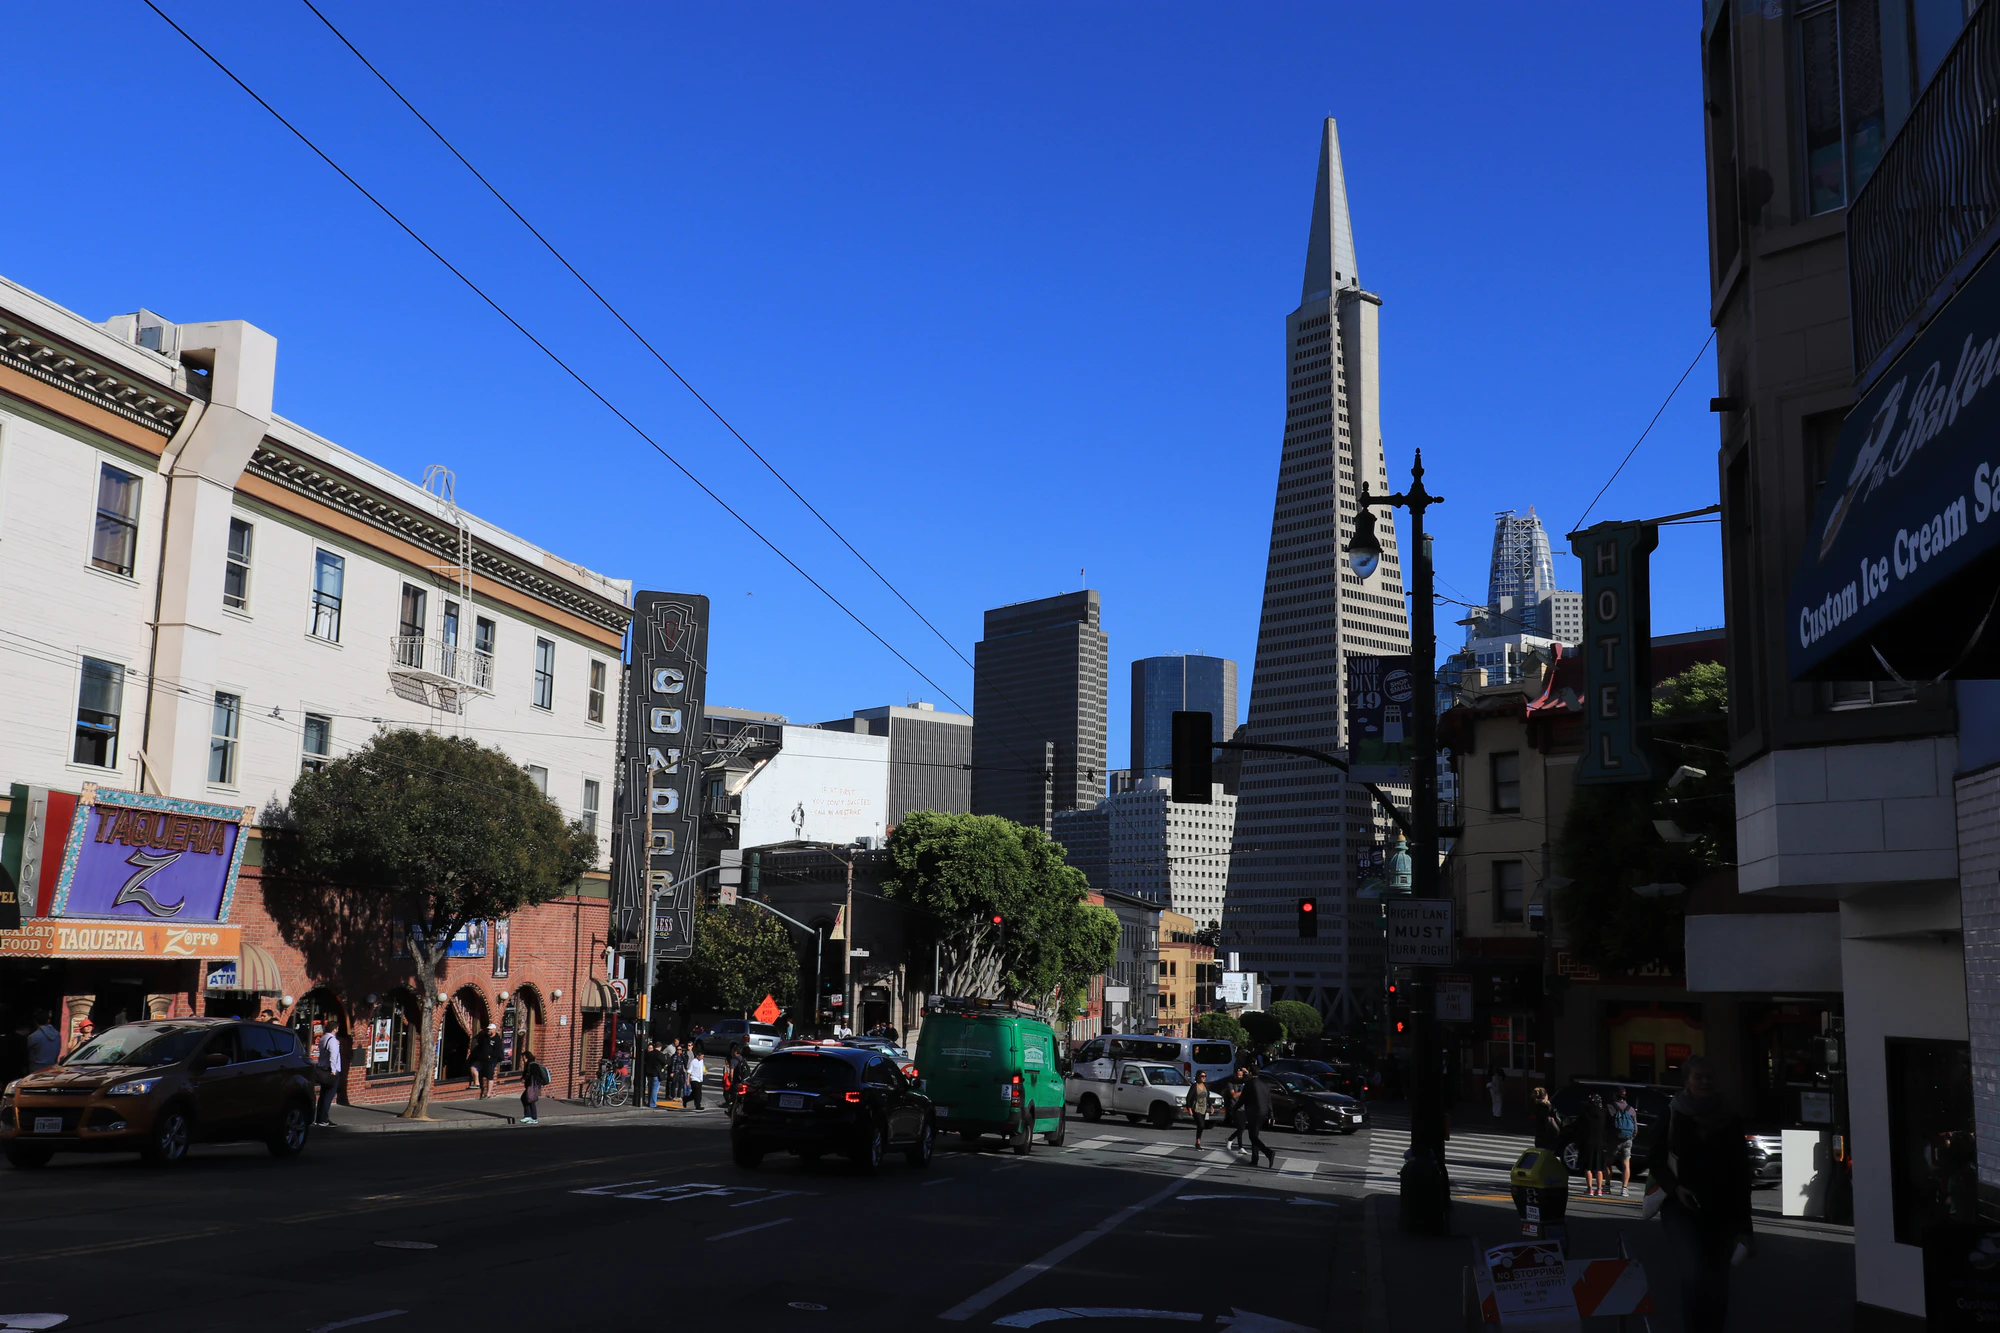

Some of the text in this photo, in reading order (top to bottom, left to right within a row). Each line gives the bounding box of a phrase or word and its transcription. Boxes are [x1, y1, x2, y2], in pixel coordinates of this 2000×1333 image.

[1800, 579, 1857, 649] Custom
[1861, 557, 1889, 607] Ice
[1894, 495, 1968, 581] Cream
[1595, 539, 1621, 768] HOTEL
[1349, 658, 1380, 674] SHOP
[1350, 674, 1380, 692] DINE
[1390, 678, 1408, 688] SHOP
[1390, 683, 1412, 694] SMALL
[1350, 692, 1381, 709] 49
[640, 667, 685, 897] CONDOR
[95, 805, 226, 855] TAQUERIA
[1390, 908, 1449, 919] RIGHT LANE
[1395, 925, 1444, 938] MUST
[0, 938, 41, 951] FOOD
[58, 928, 219, 955] TAQUERIA Zorro
[1390, 944, 1449, 956] TURN RIGHT
[210, 974, 236, 985] ATM
[1437, 982, 1446, 992] NO
[1446, 994, 1461, 1002] ANY
[568, 1179, 822, 1207] LEFT
[1497, 1267, 1564, 1280] NO STOPPING
